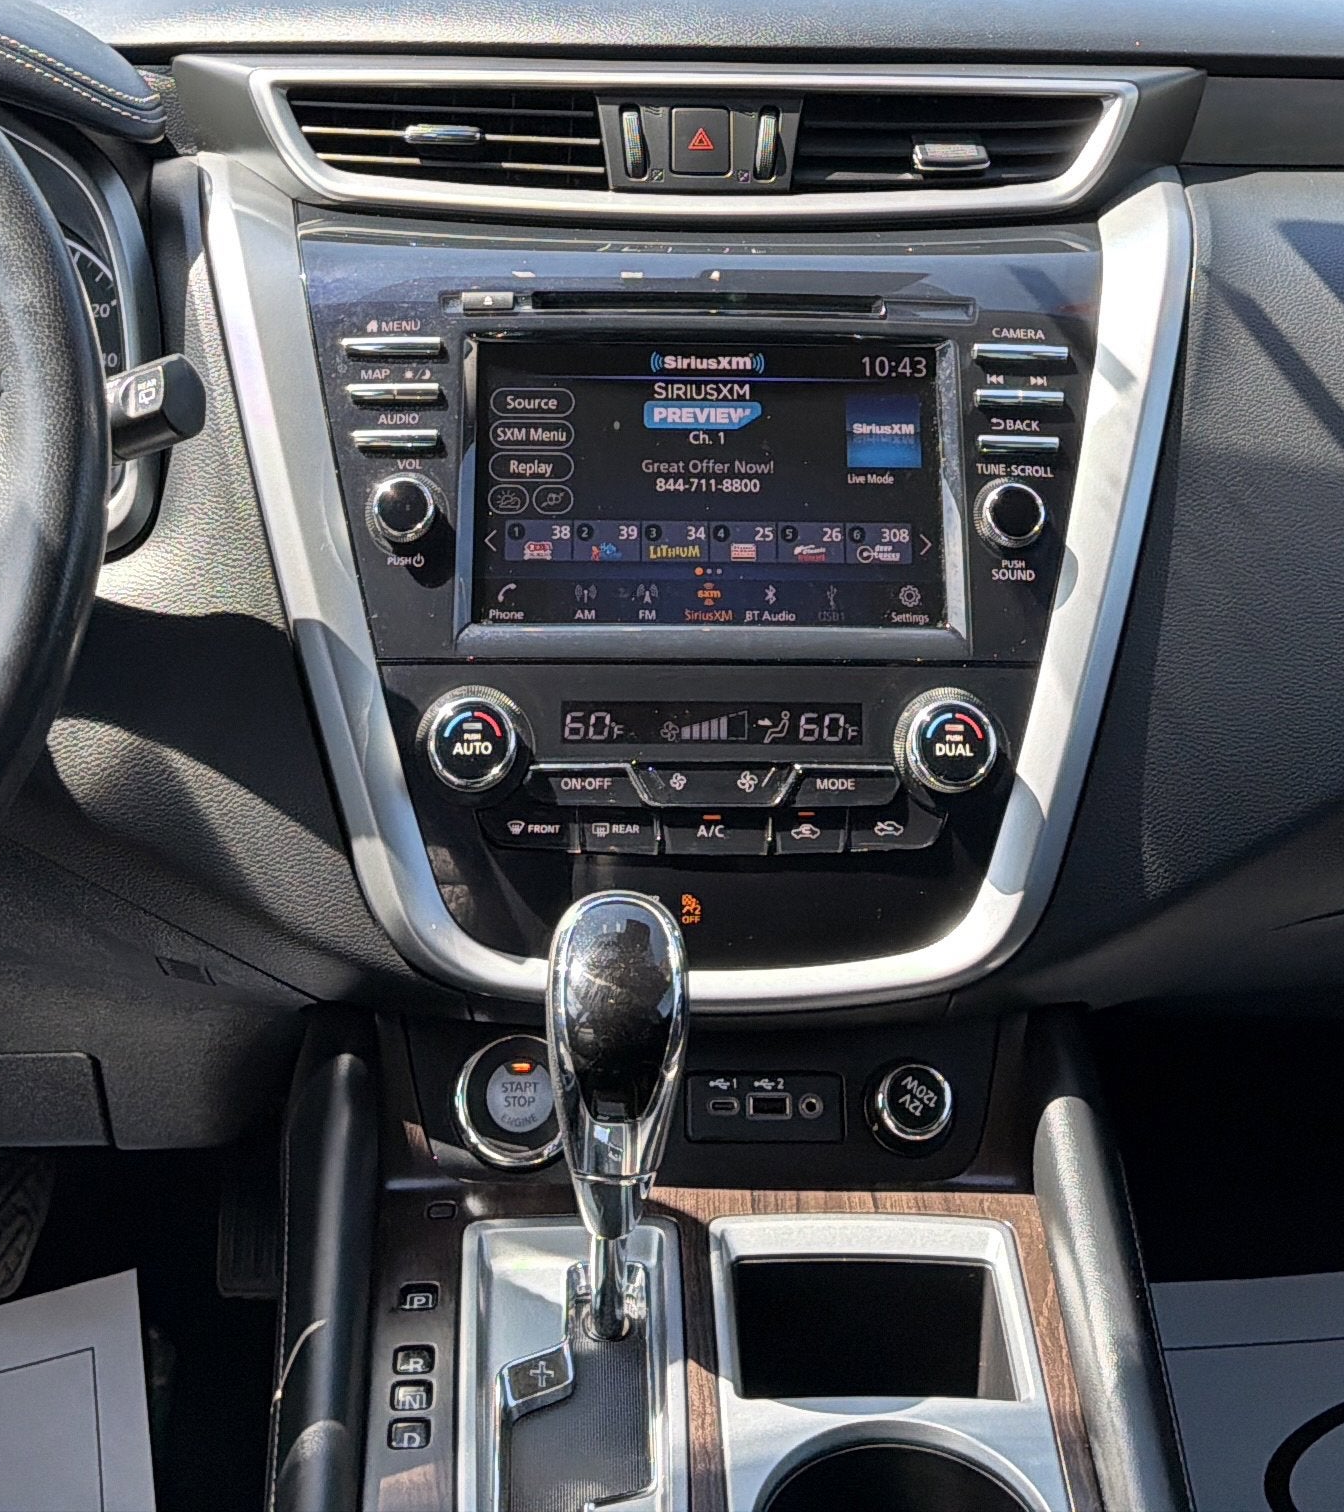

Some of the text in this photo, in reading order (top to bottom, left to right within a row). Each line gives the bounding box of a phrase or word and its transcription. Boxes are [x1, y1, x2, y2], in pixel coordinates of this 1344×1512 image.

[381, 320, 421, 332] MENU
[992, 327, 1045, 340] CAMERA
[861, 356, 927, 378] 10:43
[360, 369, 391, 380] MAP
[653, 382, 751, 400] SIRIUSXM
[506, 395, 558, 410] Source
[377, 413, 419, 425] AUDIO
[653, 407, 752, 424] PREVIEW
[1006, 419, 1040, 432] BACK
[497, 427, 567, 442] SXM Menu
[689, 430, 725, 445] Ch. 1
[397, 459, 423, 470] VOL
[509, 459, 553, 477] Replay
[641, 459, 774, 474] Great Offer Now!
[848, 472, 895, 485] Live Mode
[656, 478, 761, 493] 844-711-8800
[513, 527, 520, 537] 1
[551, 525, 571, 539] 38
[582, 527, 589, 538] 2
[618, 525, 638, 539] 39
[649, 527, 657, 538] 3
[686, 526, 706, 540] 34
[717, 528, 725, 538] 4
[754, 527, 774, 541] 25
[785, 529, 793, 539] 5
[822, 527, 842, 542] 26
[881, 528, 910, 543] 308
[387, 555, 412, 566] PUSH
[1001, 559, 1025, 569] PUSH
[992, 568, 1036, 581] SOUND
[488, 609, 525, 621] Phone
[574, 609, 596, 620] AM
[638, 610, 656, 620] FM
[684, 610, 733, 622] SiriusXM
[745, 610, 796, 622] BT Audio
[890, 611, 929, 625] Settings
[463, 733, 481, 741] PUSH
[945, 734, 963, 742] PUSH
[452, 741, 493, 755] AUTO
[935, 742, 974, 757] DUAL
[816, 777, 856, 791] MODE
[527, 824, 561, 834] FRONT
[611, 824, 640, 834] REAR
[697, 825, 725, 837] A/C
[681, 915, 700, 924] OFF
[501, 1081, 540, 1093] START
[776, 1079, 784, 1090] 2
[900, 1075, 938, 1108] 120W
[504, 1095, 536, 1108] STOP
[898, 1093, 924, 1116] 12V
[501, 1112, 538, 1127] ENGINE
[413, 1296, 426, 1308] P
[408, 1357, 424, 1373] R
[406, 1394, 420, 1409] N
[403, 1432, 421, 1447] D
